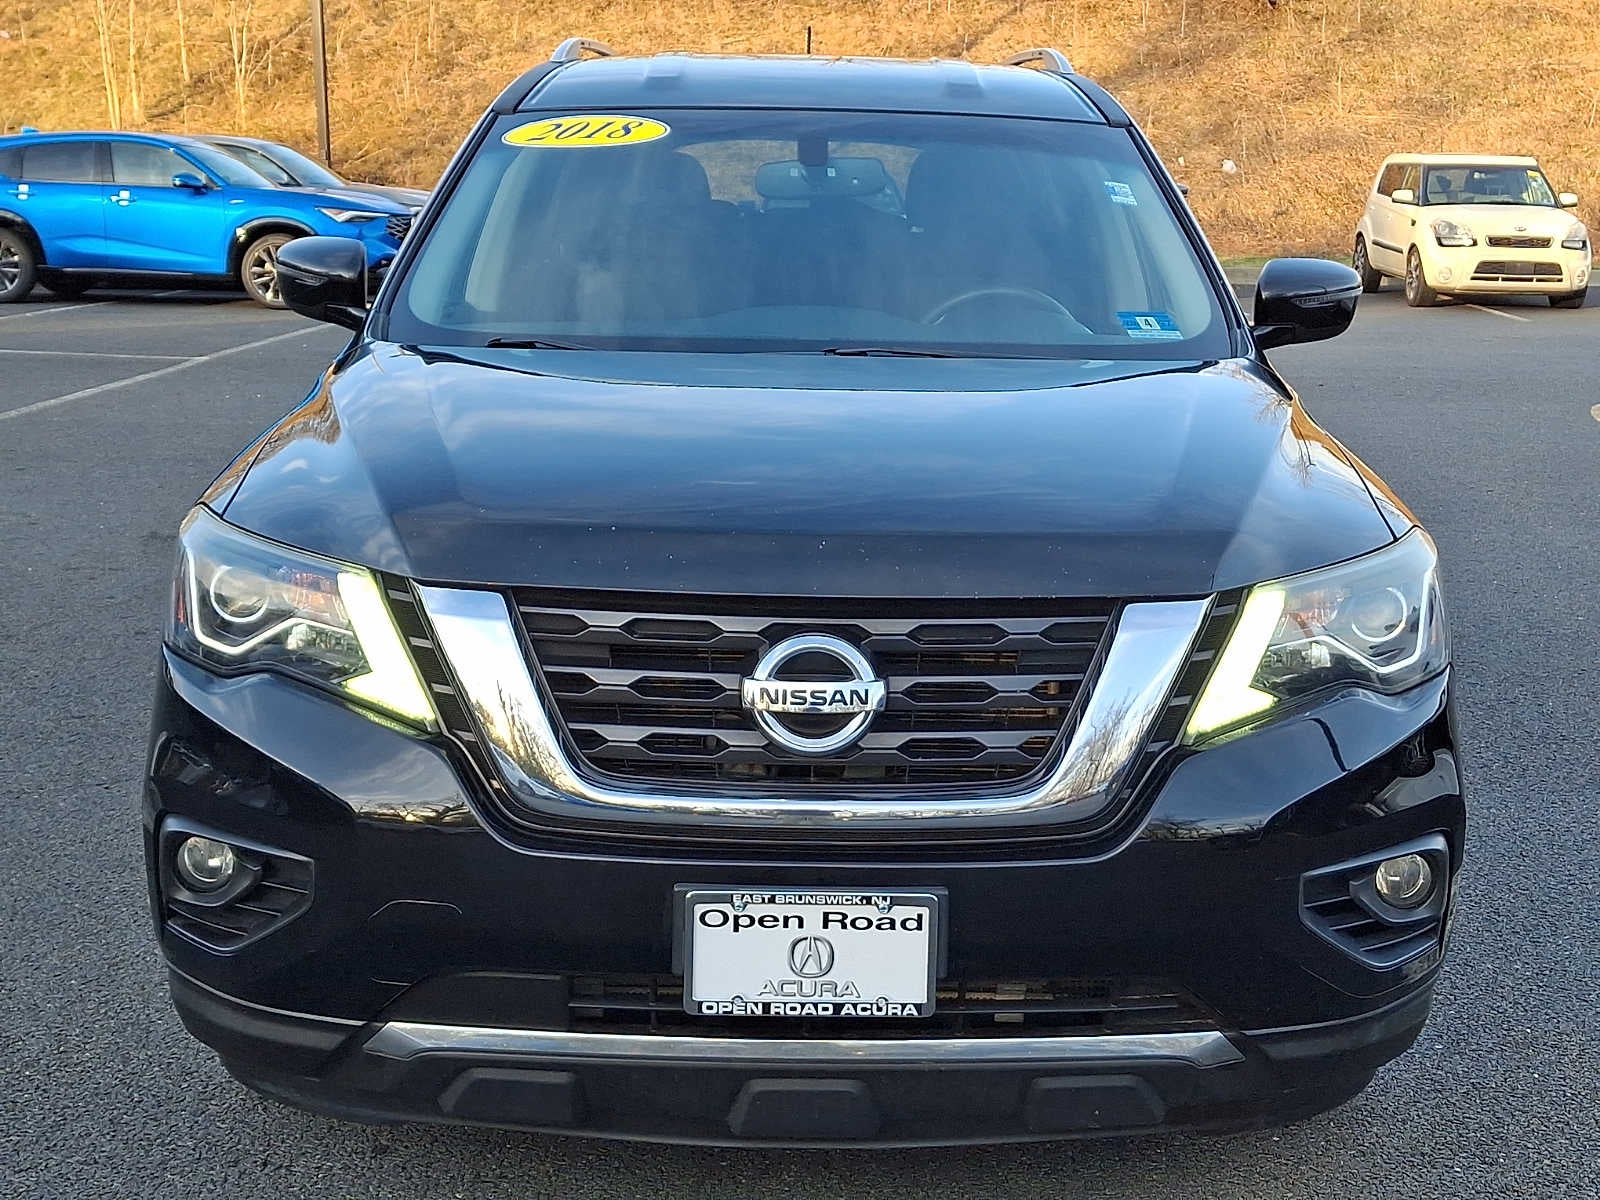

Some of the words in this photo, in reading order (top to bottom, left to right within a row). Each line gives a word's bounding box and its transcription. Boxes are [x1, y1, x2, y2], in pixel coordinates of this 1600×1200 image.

[526, 121, 643, 141] 2018
[1144, 318, 1153, 328] 4
[760, 687, 869, 706] NISSAN
[732, 893, 771, 905] EAST
[871, 896, 891, 906] NJ
[699, 908, 805, 932] Open
[822, 911, 924, 932] Road
[756, 979, 862, 999] ACURA
[701, 1001, 764, 1015] OPEN
[770, 1002, 834, 1016] ROAD
[839, 1003, 919, 1017] ACURA
